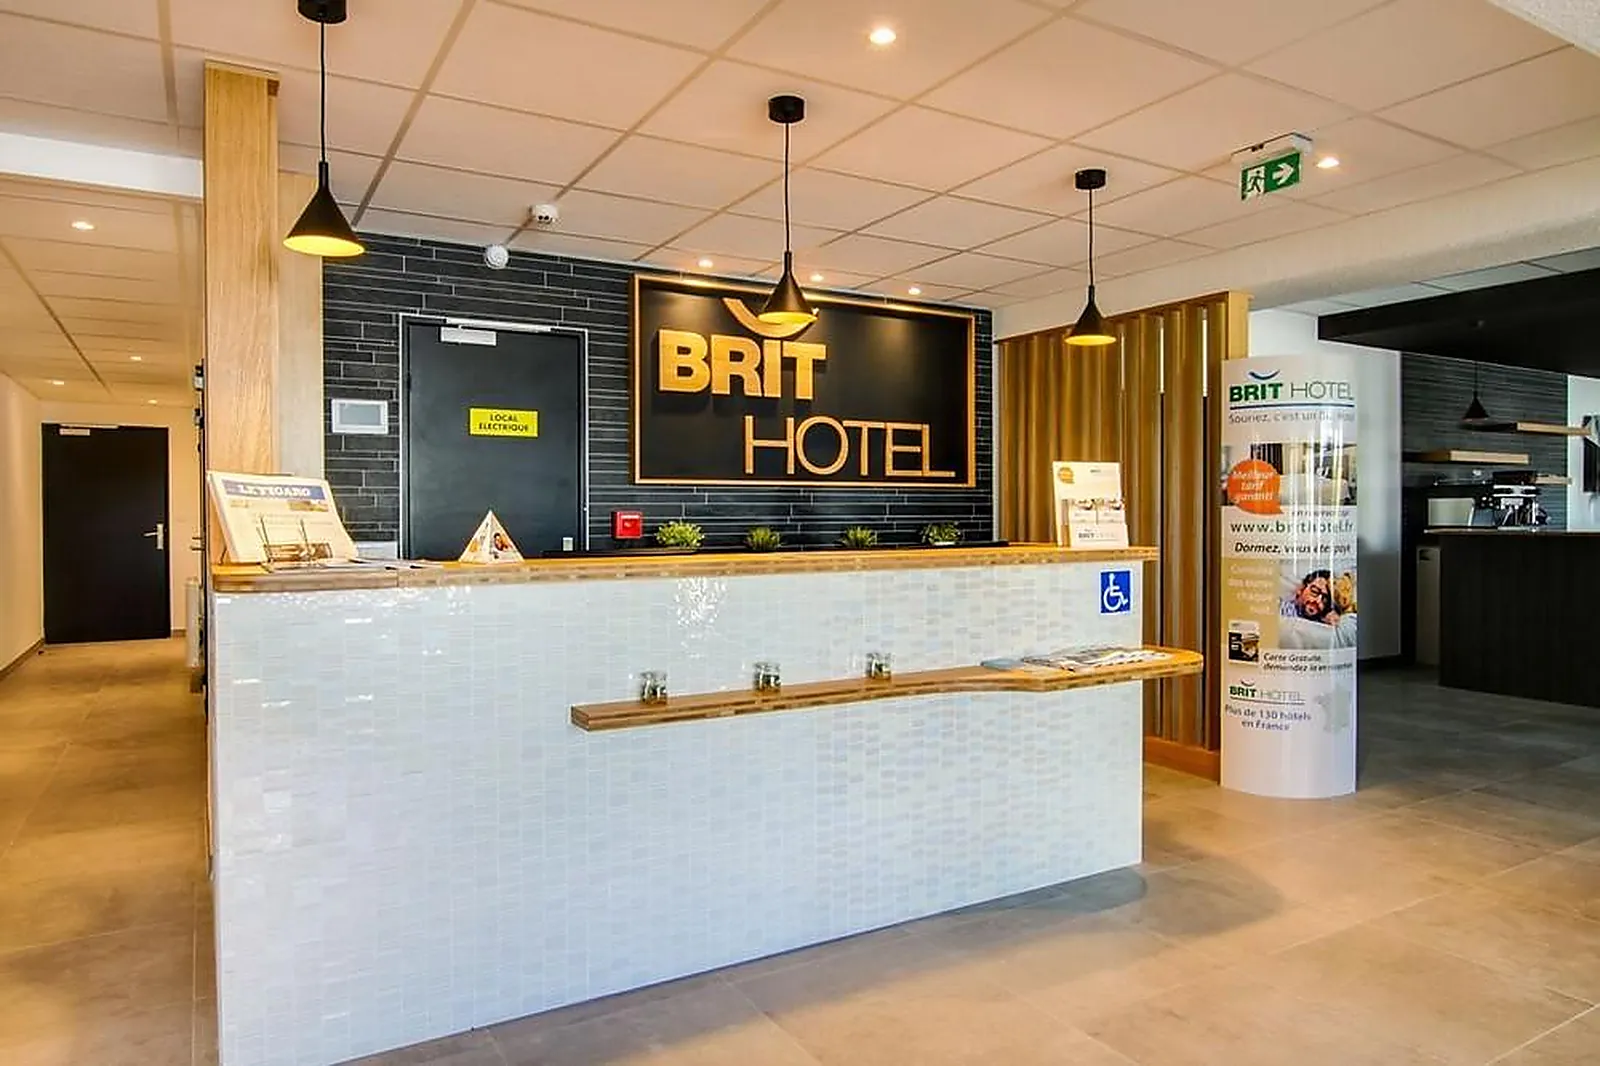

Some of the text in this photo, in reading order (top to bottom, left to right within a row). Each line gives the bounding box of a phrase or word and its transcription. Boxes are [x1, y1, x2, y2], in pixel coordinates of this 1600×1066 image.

[658, 329, 826, 400] BRIT
[1229, 380, 1355, 402] BRIT HOTEL
[490, 413, 518, 421] LOCAL
[744, 415, 956, 477] HOTEL
[260, 485, 312, 497] FIGARO
[1234, 542, 1281, 555] Dormez,
[1229, 685, 1257, 698] BRIT
[1225, 704, 1241, 716] Plus
[1244, 708, 1256, 717] de
[1259, 709, 1277, 719] 130
[1241, 720, 1290, 731] en France
